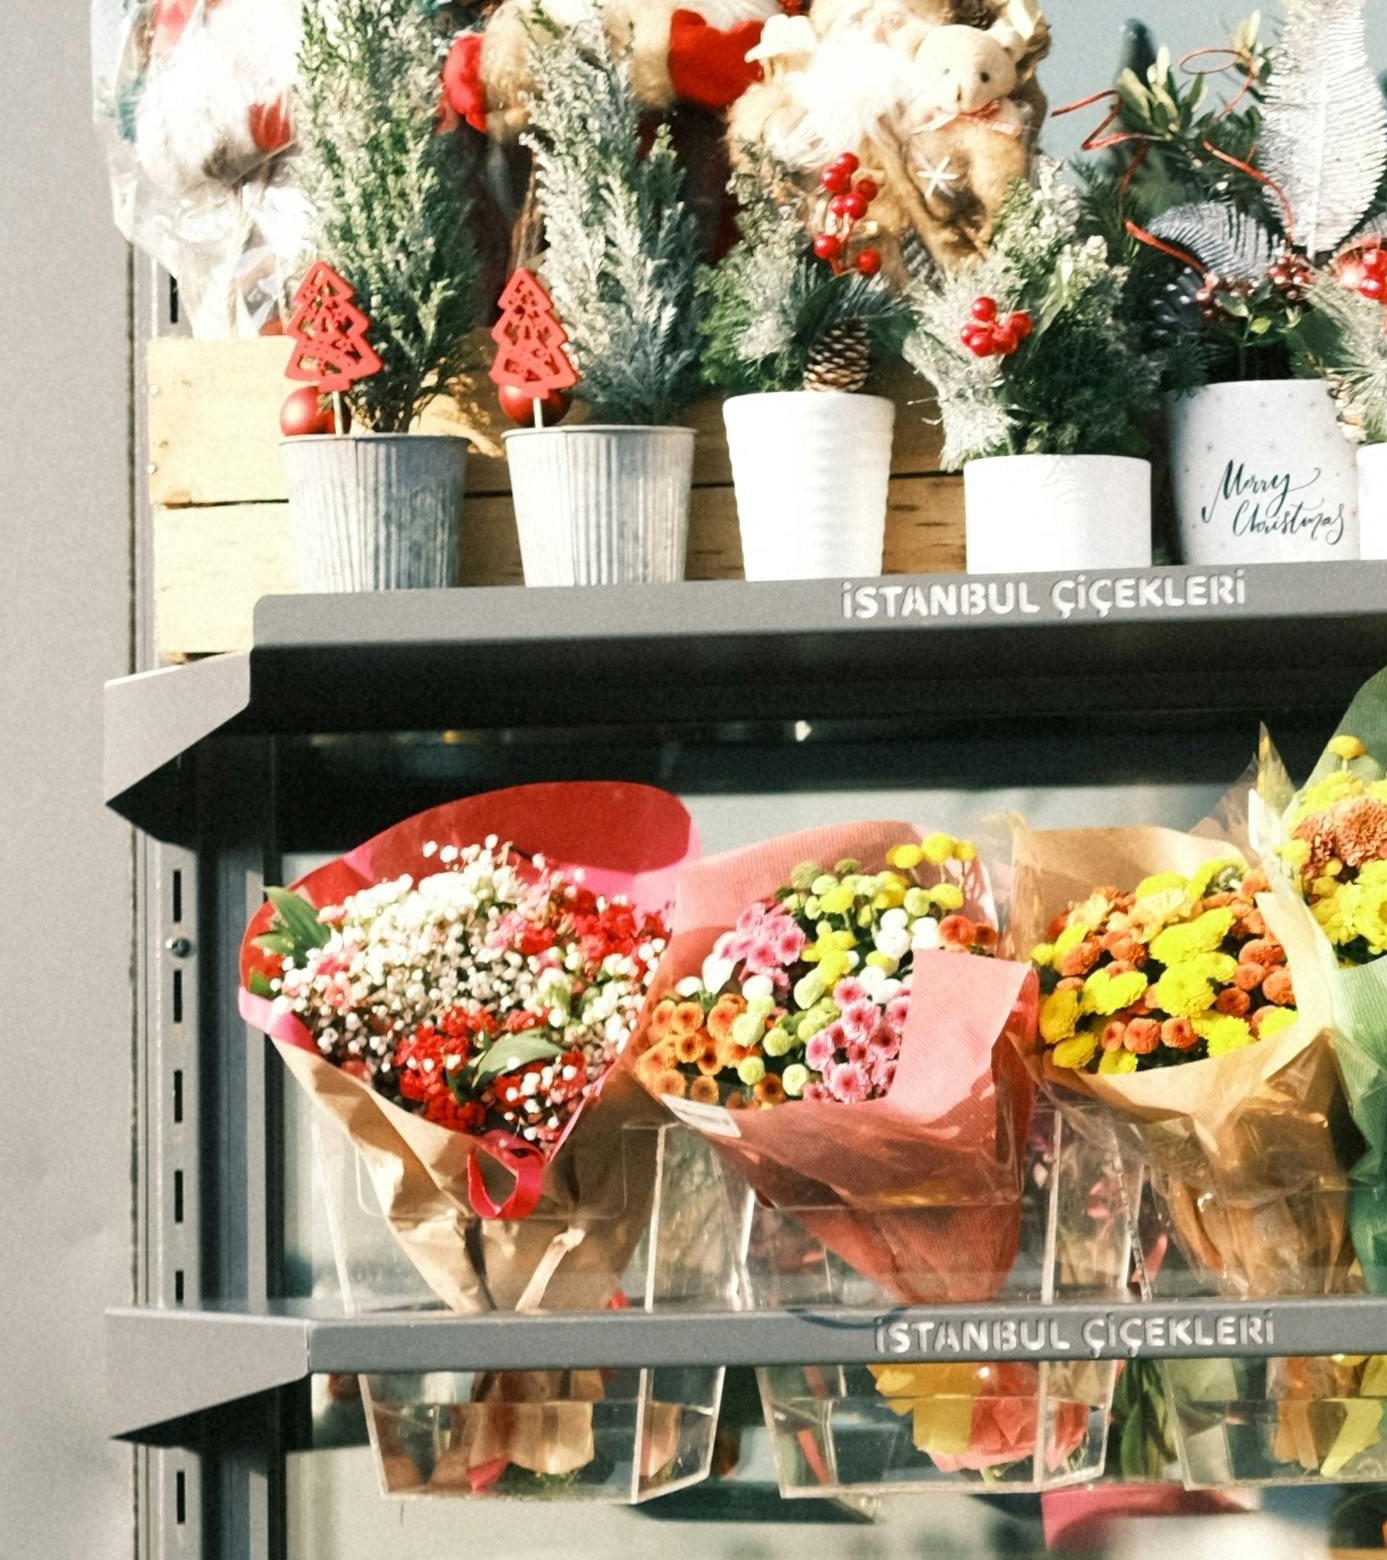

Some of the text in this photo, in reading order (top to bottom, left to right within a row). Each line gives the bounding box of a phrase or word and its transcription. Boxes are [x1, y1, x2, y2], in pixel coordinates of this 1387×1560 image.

[1201, 459, 1322, 524] Merry
[1232, 497, 1345, 545] Christmas
[841, 568, 1246, 621] İSTANBUL ÇİÇEKLERİ
[874, 1310, 1276, 1358] İSTANBUL ÇİÇEKLERİ
